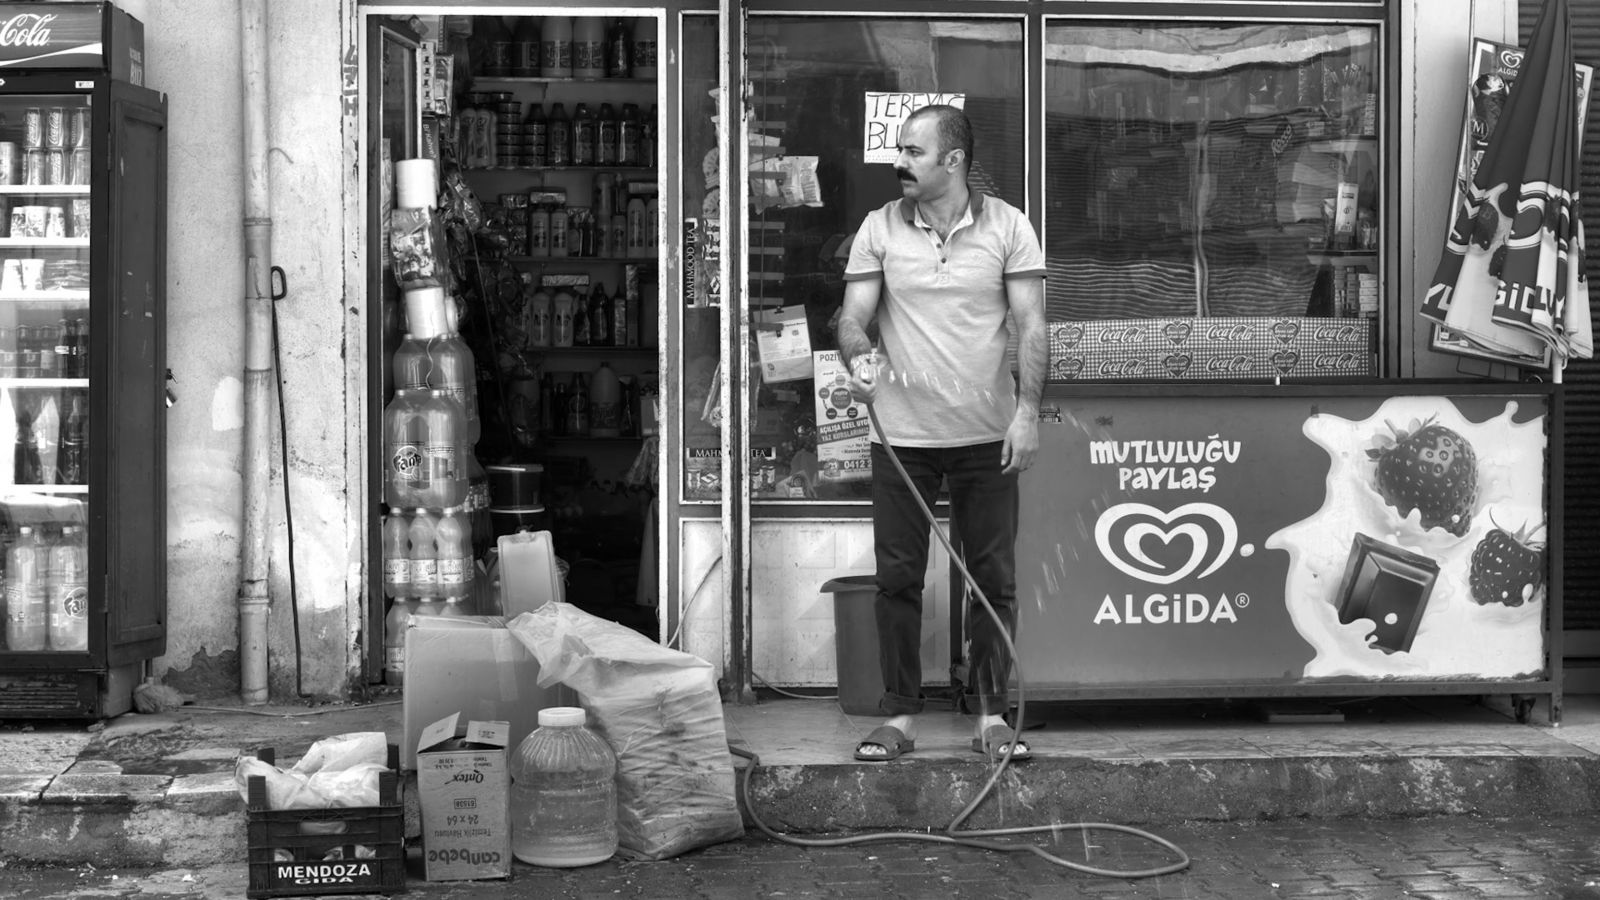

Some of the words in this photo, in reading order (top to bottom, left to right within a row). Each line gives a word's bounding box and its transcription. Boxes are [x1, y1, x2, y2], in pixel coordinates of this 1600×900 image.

[686, 229, 695, 244] TEA
[686, 246, 695, 299] MAHMOOD
[856, 418, 869, 427] UYG
[695, 448, 723, 458] MAHM
[446, 815, 458, 826] 64
[468, 814, 479, 825] 24
[428, 848, 501, 866] canbebe
[278, 863, 371, 879] MENDOZA
[295, 877, 354, 885] GIDA
